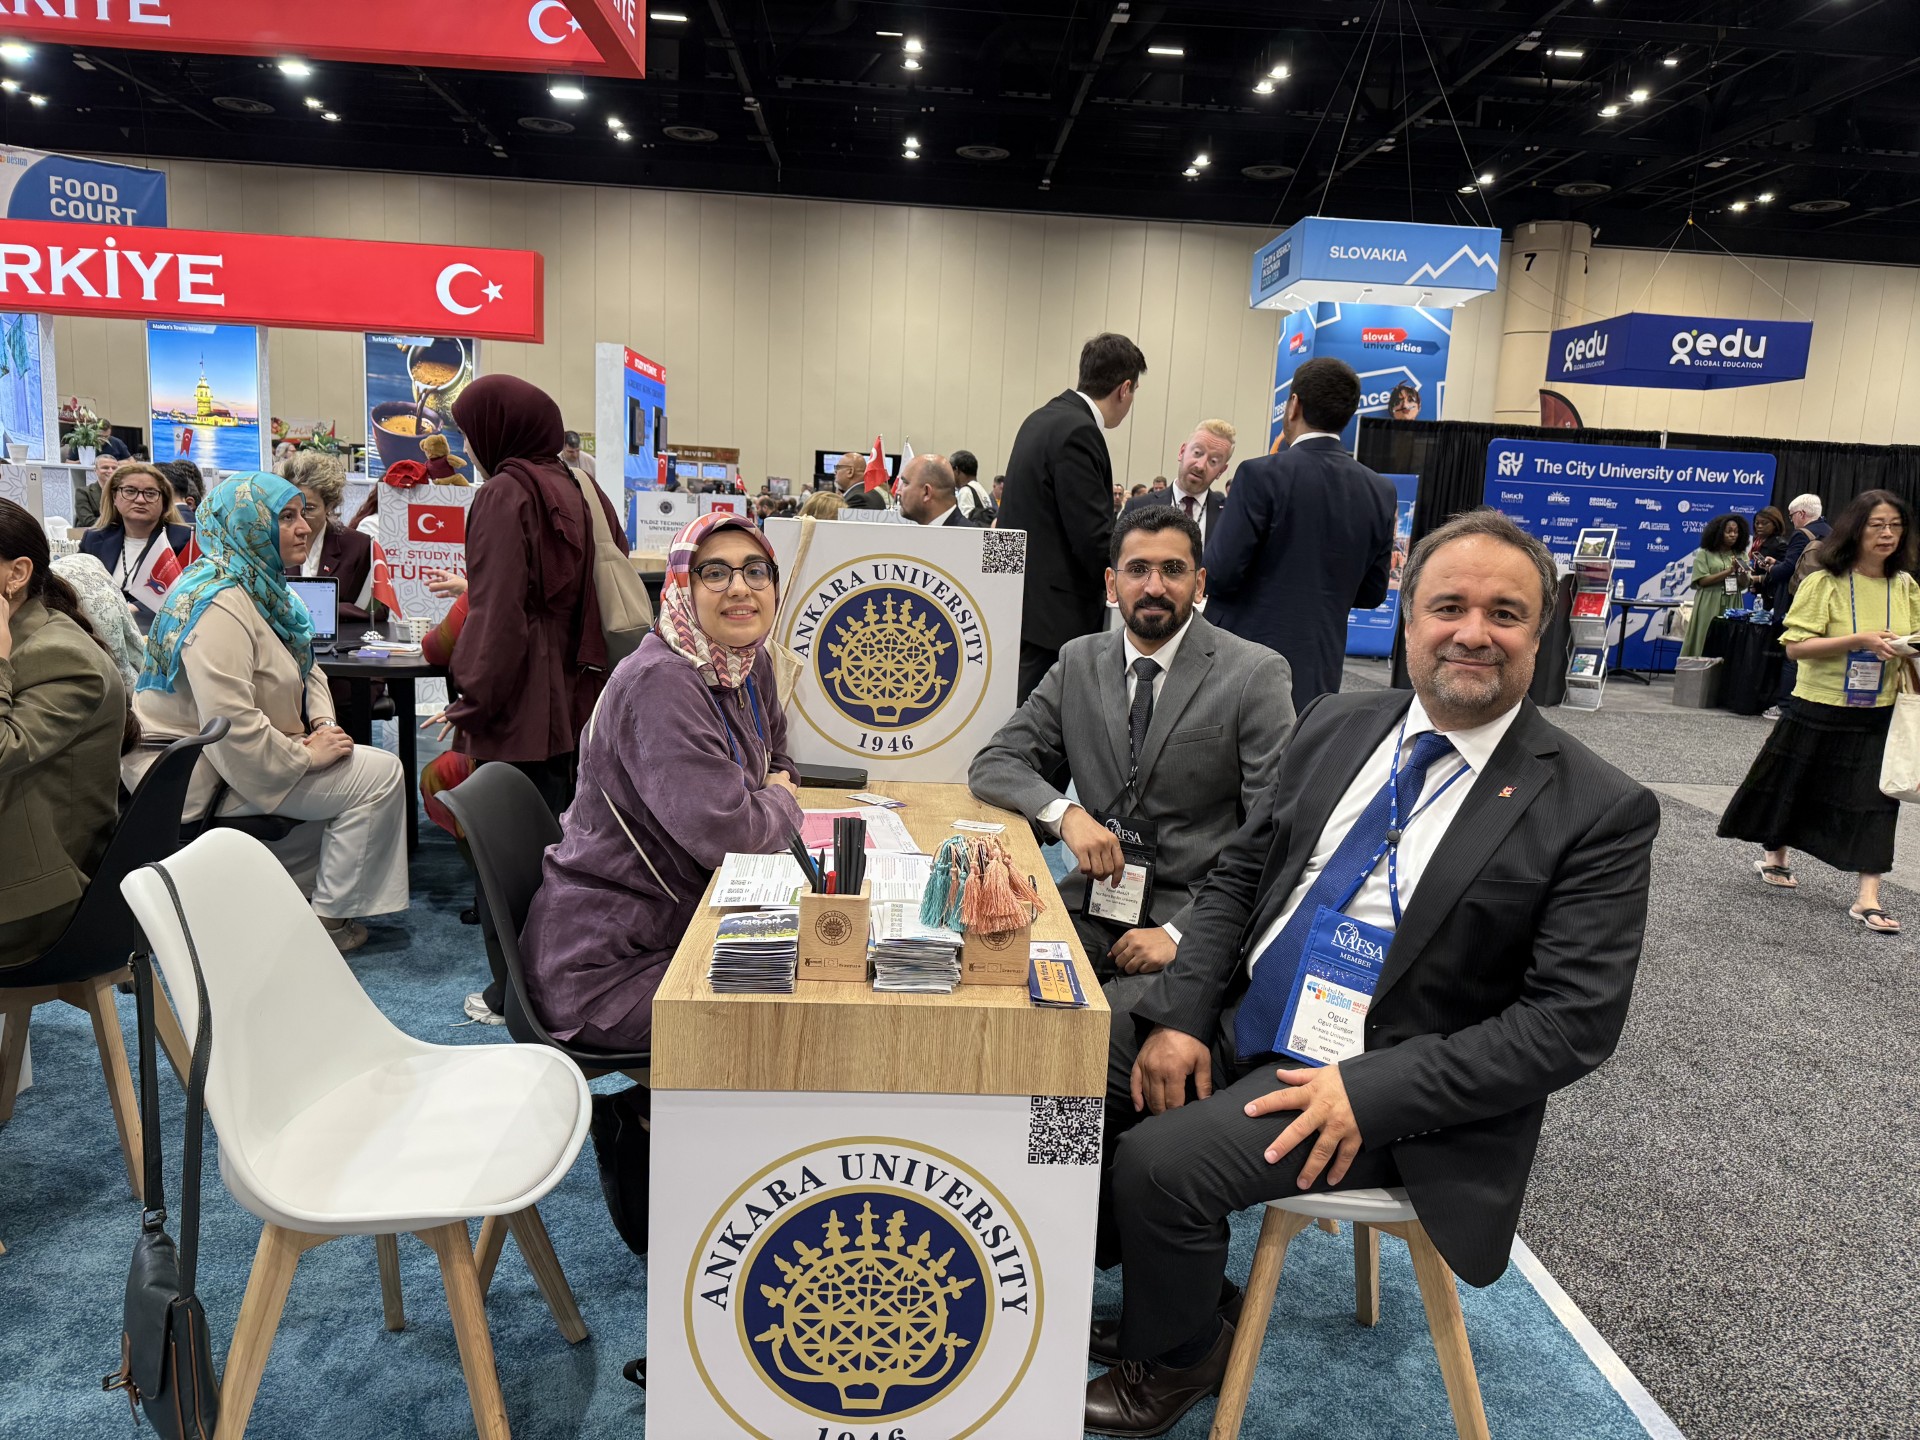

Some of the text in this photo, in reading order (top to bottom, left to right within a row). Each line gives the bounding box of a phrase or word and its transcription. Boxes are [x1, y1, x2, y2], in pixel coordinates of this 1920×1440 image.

[49, 175, 118, 203] FOOD
[50, 197, 137, 226] COURT
[1329, 246, 1408, 263] SLOVAKIA
[1524, 253, 1537, 272] 7
[1363, 332, 1395, 341] slovak
[1364, 342, 1422, 353] universities
[1563, 330, 1609, 373] gedu
[1669, 328, 1767, 366] gedu
[1722, 361, 1763, 369] EDUCATION
[1534, 458, 1764, 485] The City University of New York
[1501, 491, 1524, 500] Baruch
[407, 550, 450, 561] STUDY
[793, 563, 983, 666] ANKARA UNIVERSITY
[857, 733, 914, 752] 1946
[1332, 929, 1384, 960] NAFSA
[1339, 952, 1372, 968] MEMBER
[1327, 1011, 1348, 1025] Oguz
[700, 1153, 1029, 1316] ANKARA UNIVERSITY
